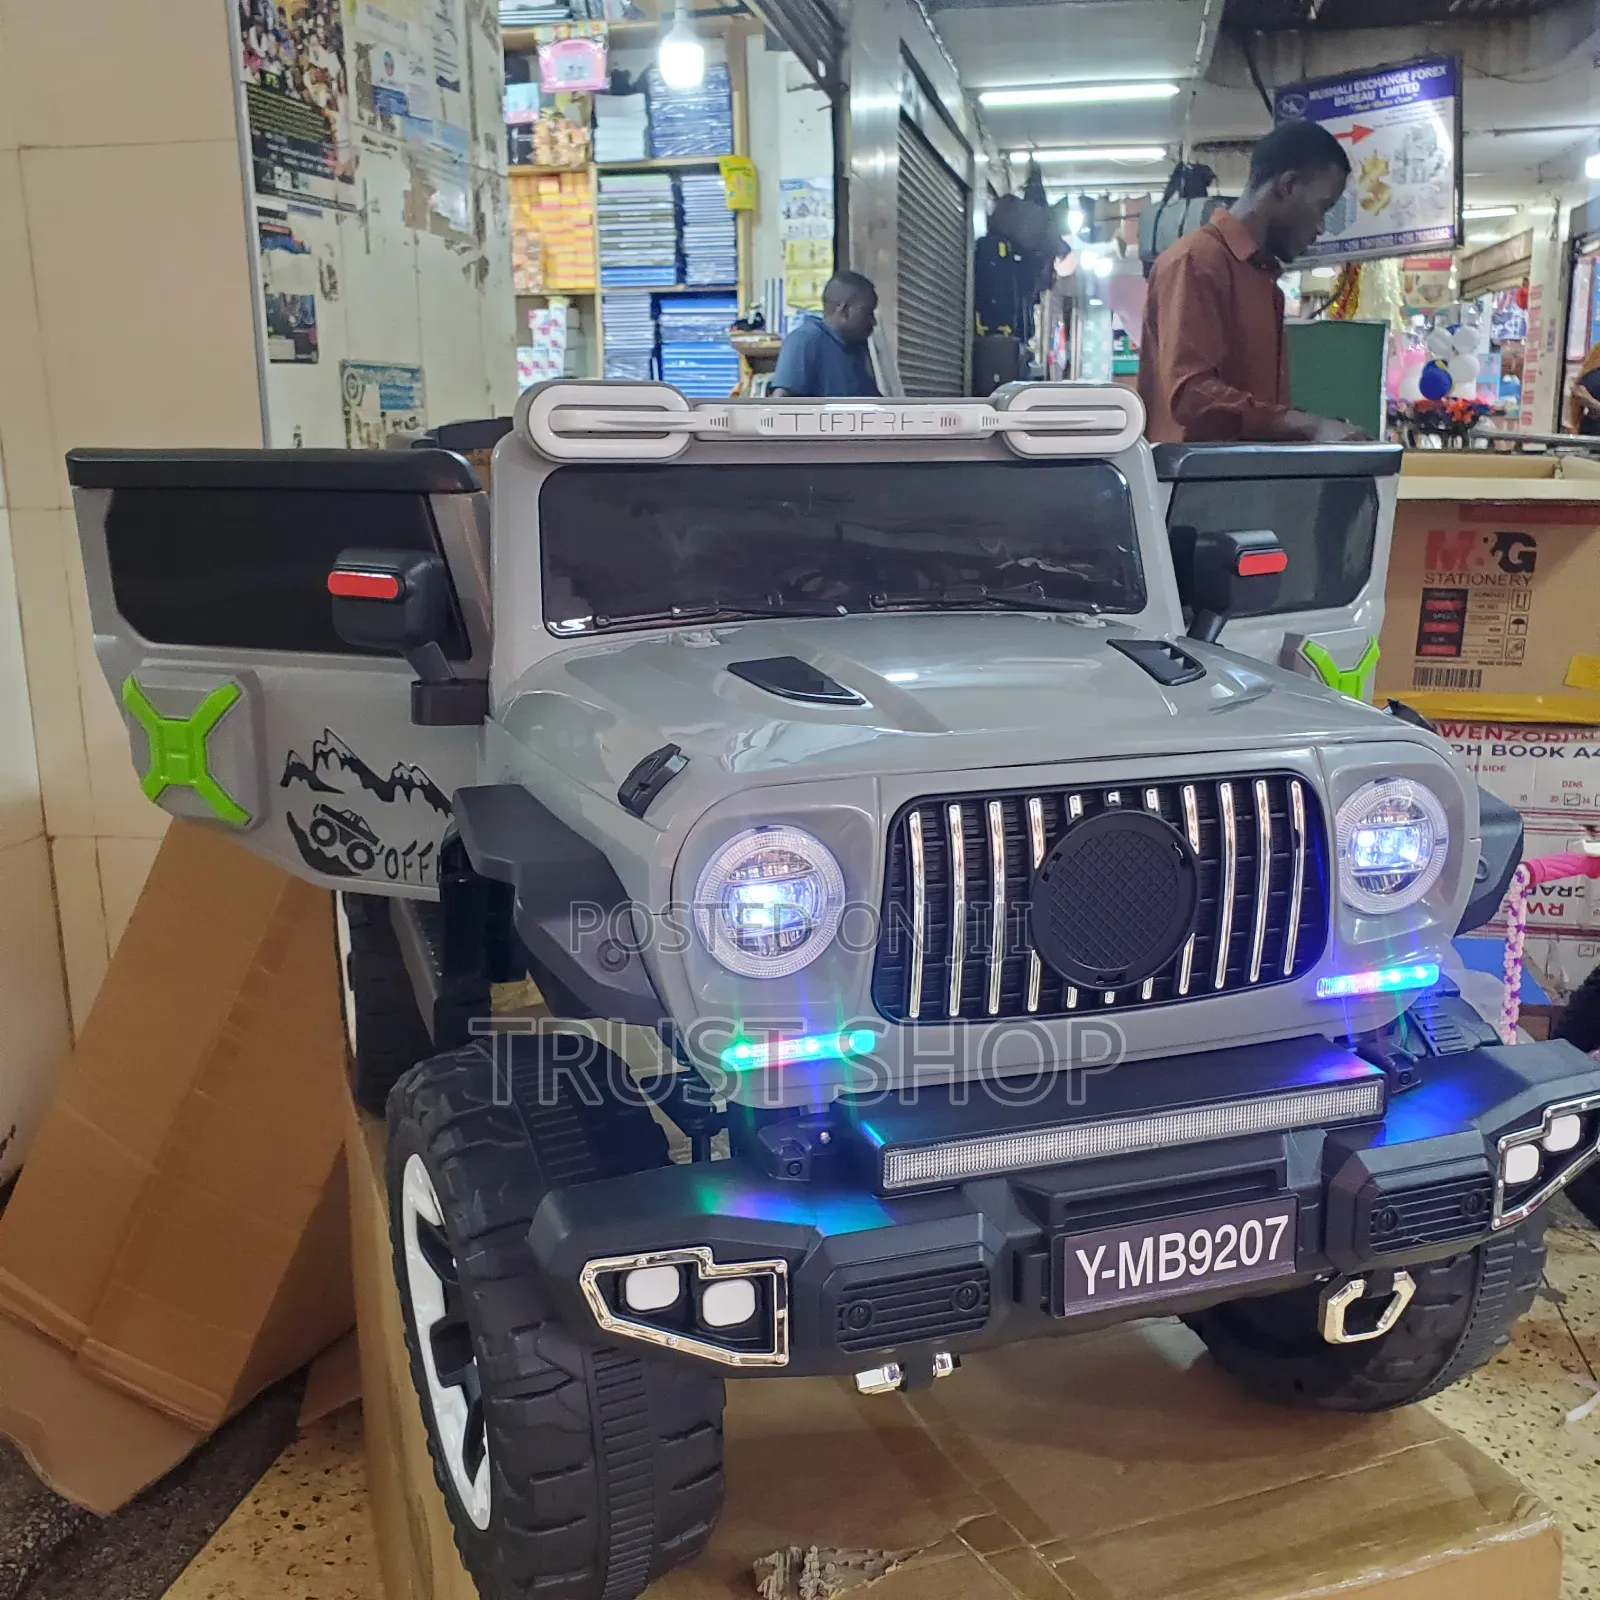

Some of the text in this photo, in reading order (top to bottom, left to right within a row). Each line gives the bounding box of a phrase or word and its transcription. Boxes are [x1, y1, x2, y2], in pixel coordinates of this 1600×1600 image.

[1354, 72, 1410, 92] EXCHANGE
[1411, 65, 1447, 81] FOREX
[1334, 90, 1376, 107] BUREAU
[1380, 82, 1420, 98] LIMITED
[1423, 573, 1533, 587] STATIONERY
[1492, 744, 1565, 758] BOOK
[1482, 765, 1507, 773] SIDE
[1075, 1215, 1289, 1296] Y-MB9207
